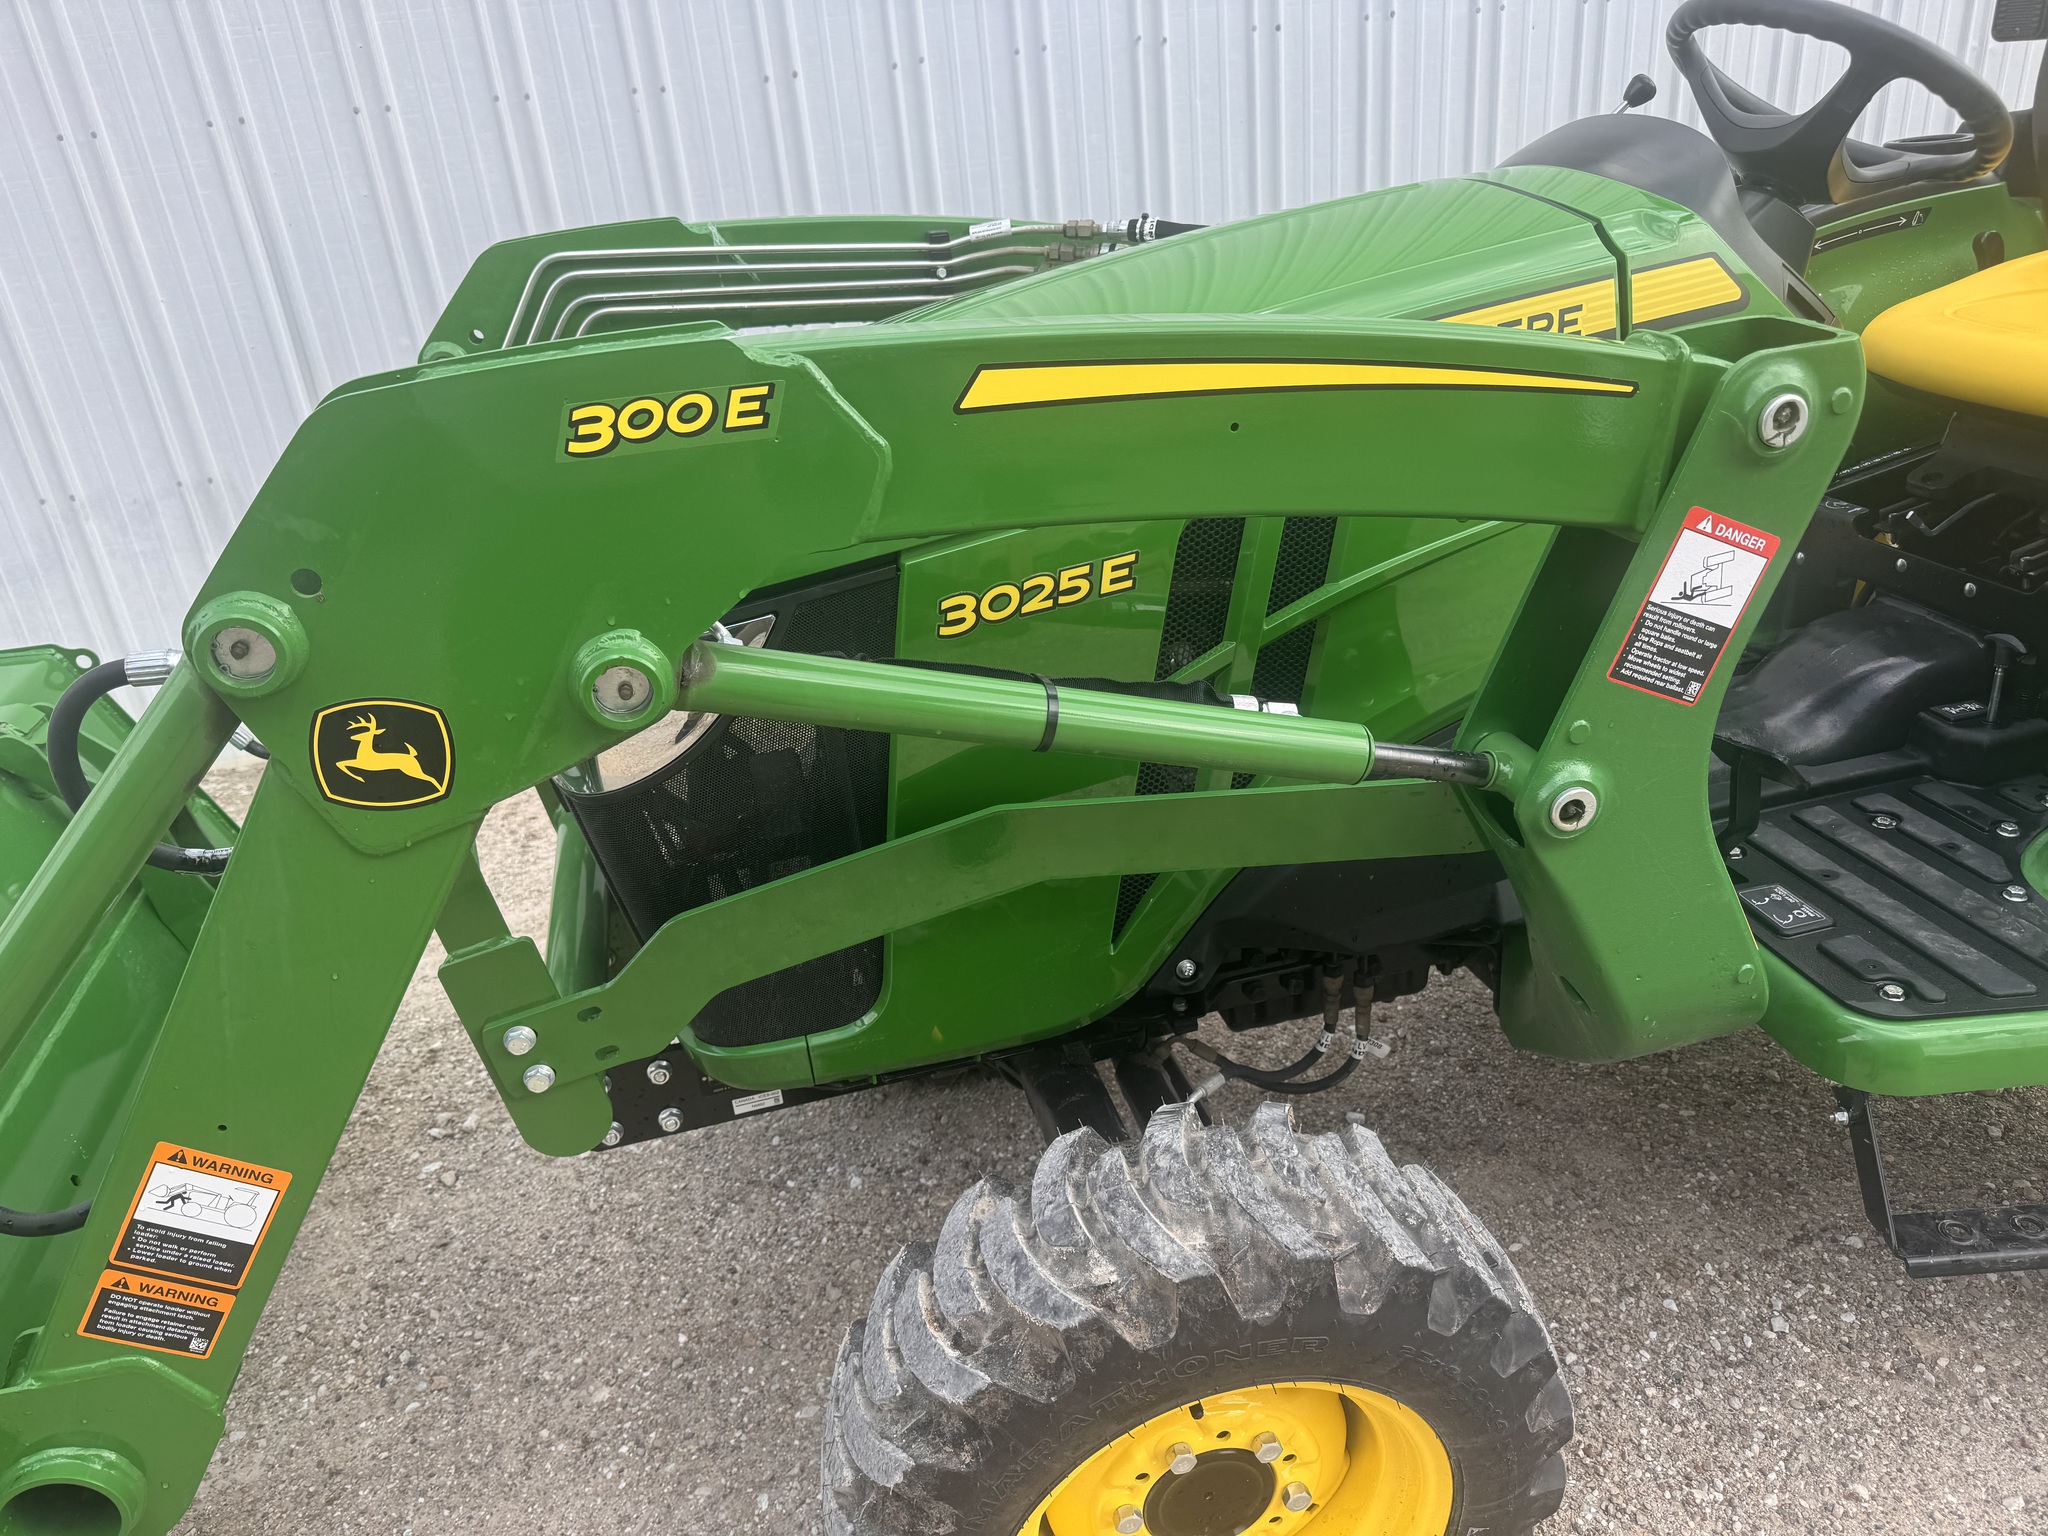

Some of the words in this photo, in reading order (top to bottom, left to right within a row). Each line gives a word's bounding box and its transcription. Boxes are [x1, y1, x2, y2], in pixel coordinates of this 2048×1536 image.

[1715, 523, 1766, 551] DANGER
[1647, 604, 1667, 615] Serious
[1668, 611, 1683, 622] injury
[1690, 618, 1705, 628] death
[1660, 616, 1672, 625] from
[1672, 621, 1696, 634] rollovers.
[1638, 633, 1649, 642] Use
[1649, 637, 1664, 647] Rops
[1663, 642, 1675, 650] and
[1674, 647, 1696, 658] seatbelt
[1641, 628, 1660, 638] square
[1660, 632, 1675, 643] bales.
[1663, 626, 1681, 636] handle
[1682, 632, 1698, 642] round
[1704, 640, 1717, 649] large
[1642, 644, 1658, 653] times.
[1624, 662, 1662, 678] recommended
[1662, 674, 1681, 685] setting.
[1627, 654, 1642, 664] Move
[1643, 659, 1662, 670] wheels
[1668, 668, 1687, 678] widest
[1631, 647, 1653, 660] Operate
[1653, 656, 1672, 665] tractor
[1678, 663, 1688, 671] low
[1688, 666, 1705, 677] speed.
[1620, 668, 1632, 676] Add
[1632, 673, 1654, 683] required
[1665, 682, 1684, 694] ballast.
[192, 1156, 274, 1184] WARNING
[162, 1242, 178, 1250] walk
[189, 1248, 217, 1257] perform
[167, 1231, 186, 1239] injury
[188, 1235, 204, 1244] from
[206, 1239, 227, 1249] falling
[130, 1254, 157, 1264] parked.
[132, 1248, 155, 1257] Lower
[155, 1252, 178, 1261] loader
[188, 1260, 213, 1269] ground
[135, 1243, 160, 1252] service
[162, 1248, 182, 1257] under
[190, 1254, 211, 1263] raised
[213, 1259, 235, 1268] loader.
[139, 1282, 219, 1308] WARNING
[104, 1308, 126, 1316] Failure
[136, 1314, 160, 1323] engage
[161, 1319, 186, 1328] retainer
[186, 1324, 205, 1332] could
[108, 1300, 138, 1310] engaging
[139, 1305, 176, 1317] attachment
[177, 1312, 195, 1320] latch.
[138, 1300, 164, 1309] operate
[164, 1304, 185, 1314] loader
[186, 1309, 211, 1318] without
[97, 1324, 116, 1333] bodily
[118, 1328, 136, 1336] injury
[146, 1334, 166, 1342] death.
[101, 1314, 120, 1322] result
[128, 1320, 166, 1330] attachment
[167, 1326, 198, 1336] detaching
[116, 1321, 136, 1330] loader
[138, 1327, 163, 1336] causing
[164, 1332, 188, 1340] serious
[963, 1336, 1329, 1531] MARATHONER
